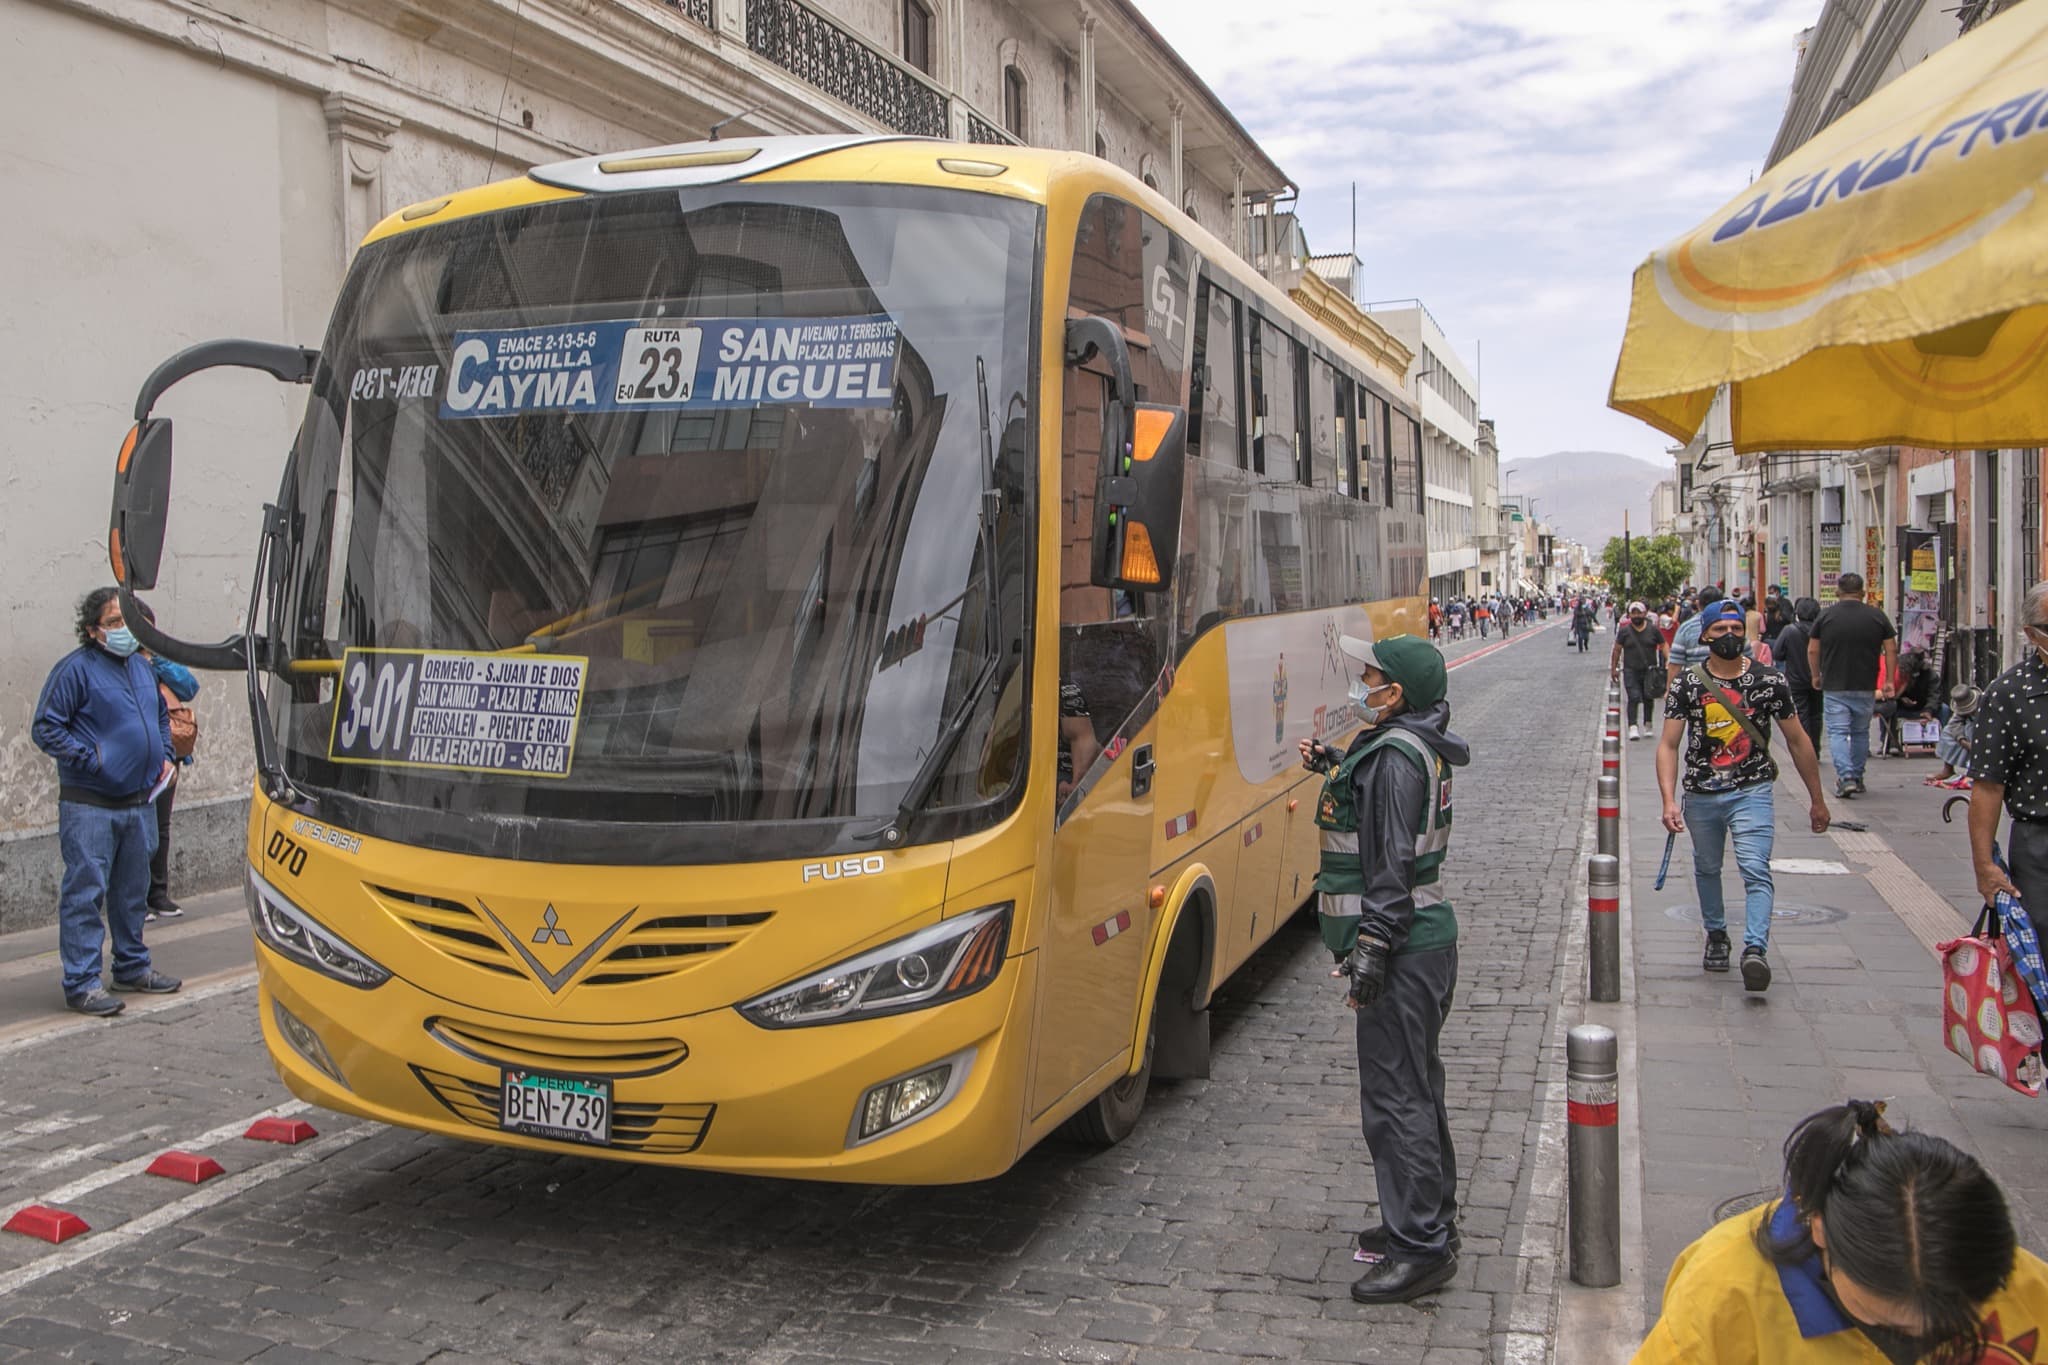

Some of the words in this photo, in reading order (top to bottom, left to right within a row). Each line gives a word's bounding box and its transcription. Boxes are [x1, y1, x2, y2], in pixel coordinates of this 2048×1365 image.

[498, 337, 542, 353] ENACE
[544, 330, 597, 350] 2-13-5-6
[644, 331, 681, 343] RUTA
[719, 327, 801, 362] SAN
[801, 326, 838, 342] AVELINO
[850, 321, 897, 339] TERRESTRE
[495, 350, 592, 372] TOMILLA
[797, 344, 834, 360] PLAZA
[836, 344, 852, 359] DE
[855, 340, 895, 358] ARMAS
[446, 338, 597, 412] CAYMA
[633, 347, 683, 400] 23
[680, 382, 689, 398] A
[712, 363, 892, 401] MIGUEL
[425, 658, 475, 681] ORMEÑO
[485, 665, 527, 684] S.JUAN
[530, 667, 547, 684] DE
[550, 667, 580, 687] DIOS
[340, 660, 415, 750] 3-01
[417, 682, 440, 706] SAN
[442, 684, 478, 709] CAMILO
[487, 689, 520, 711] PLAZA
[522, 691, 536, 711] DE
[538, 690, 578, 715] ARMAS
[412, 711, 477, 738] JERUSALEN
[488, 718, 533, 742] PUENTE
[537, 721, 571, 744] GRAU
[409, 737, 504, 767] AV.EJERCITO
[521, 746, 564, 772] SAGA
[267, 829, 308, 877] 070
[293, 818, 362, 855] MITSUBISHI
[803, 855, 884, 883] FUSO
[508, 1084, 605, 1132] BEN-739
[530, 1126, 577, 1139] MITSUBISHI
